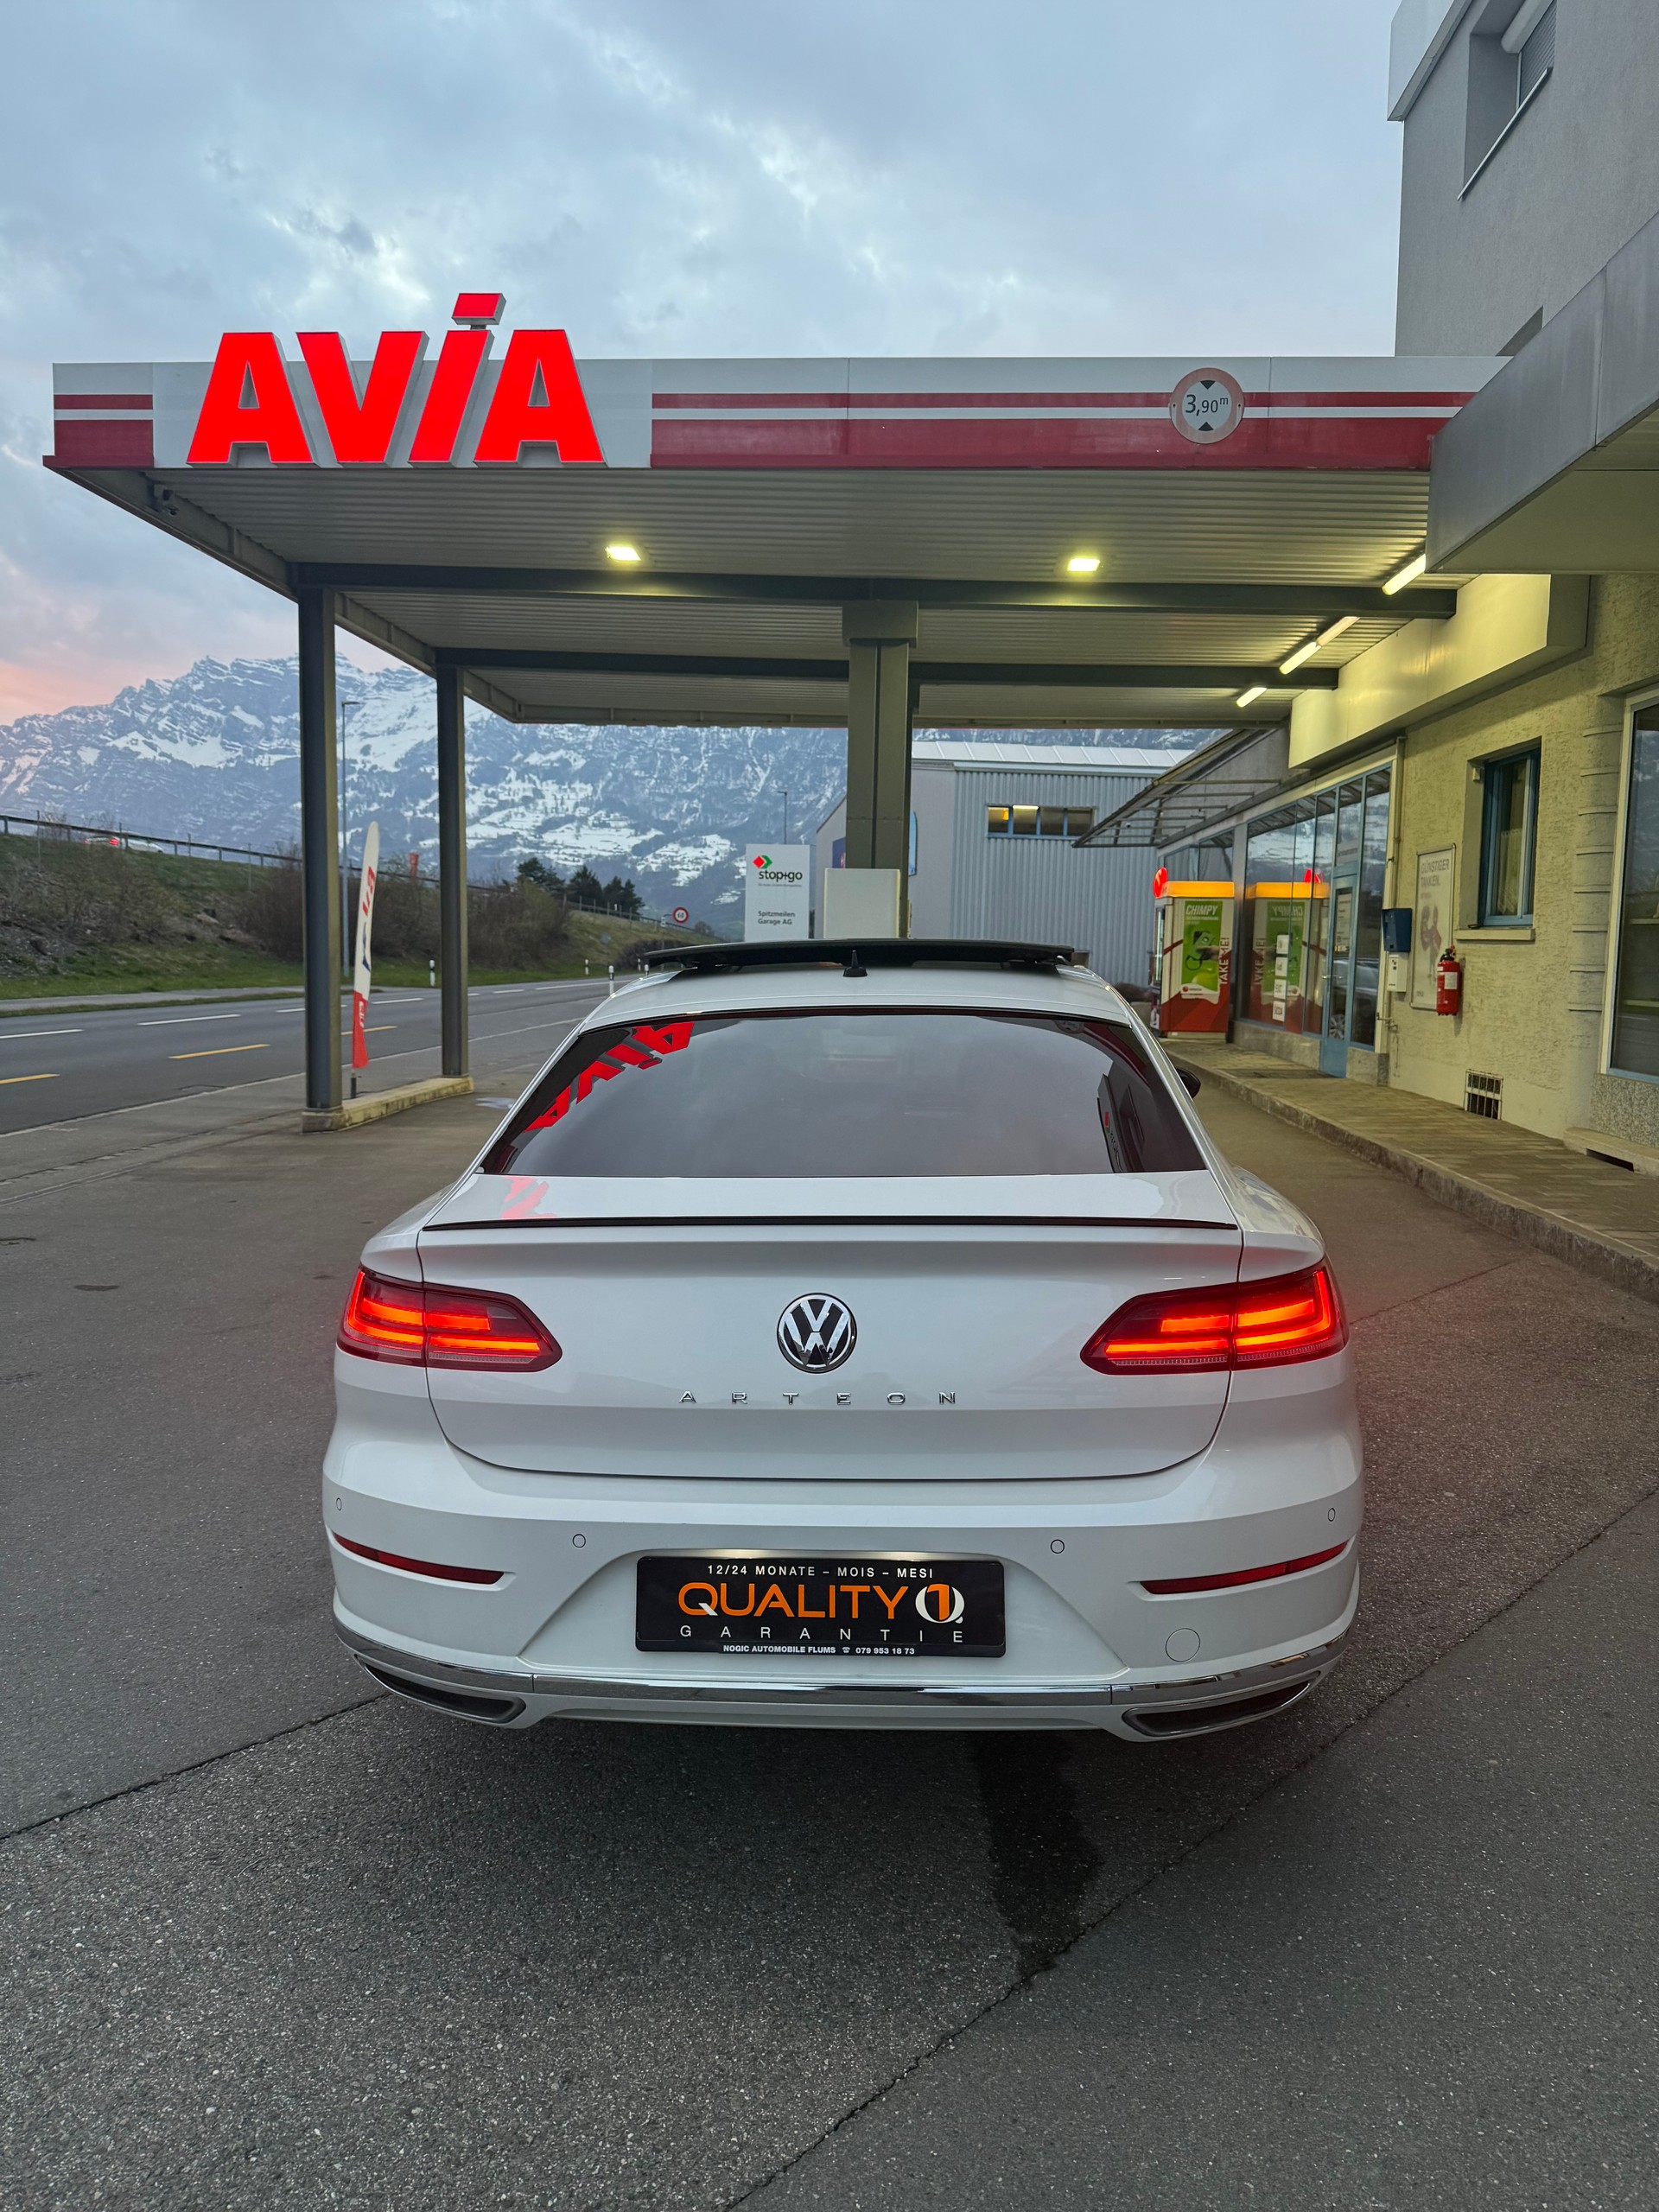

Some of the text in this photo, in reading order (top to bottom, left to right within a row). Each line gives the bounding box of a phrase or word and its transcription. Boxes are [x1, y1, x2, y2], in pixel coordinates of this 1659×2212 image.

[759, 870, 803, 882] stop+go
[1185, 905, 1218, 916] CHIMPY
[679, 1391, 956, 1405] ARTEON
[708, 1565, 747, 1575] 12/24
[755, 1566, 815, 1577] MONATE
[837, 1567, 874, 1578] MOIS
[897, 1567, 933, 1579] MESI
[677, 1582, 909, 1620] QUALITY
[680, 1625, 963, 1643] GARANTIE
